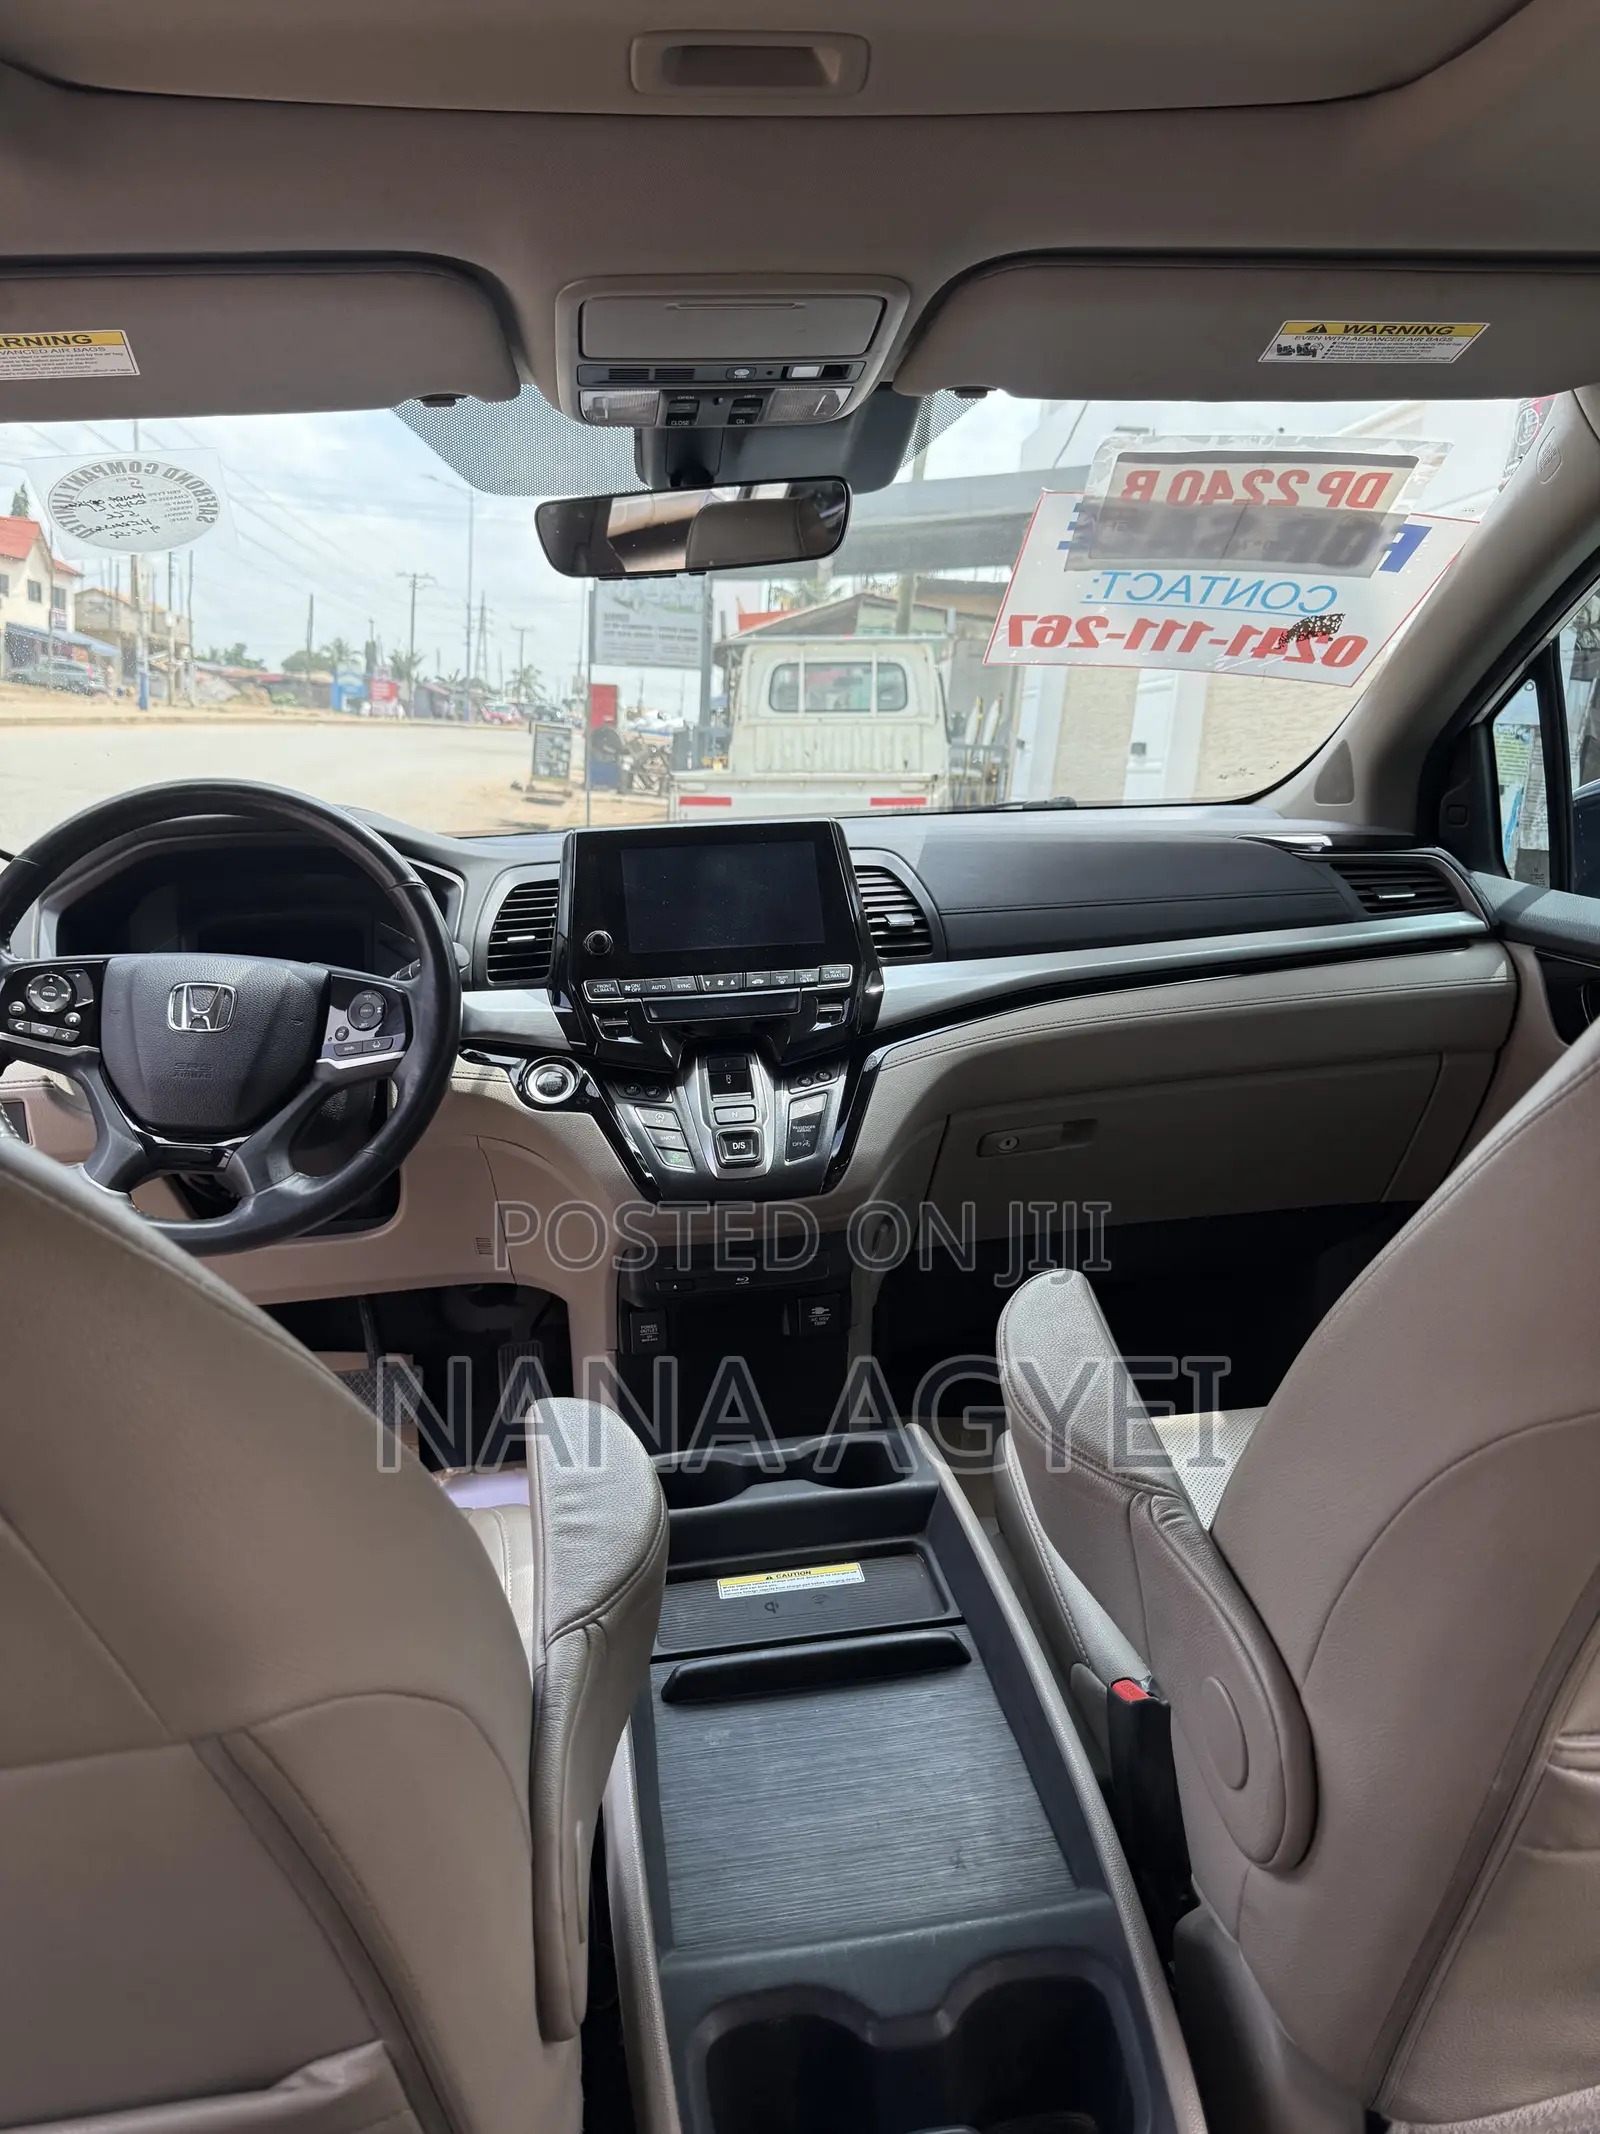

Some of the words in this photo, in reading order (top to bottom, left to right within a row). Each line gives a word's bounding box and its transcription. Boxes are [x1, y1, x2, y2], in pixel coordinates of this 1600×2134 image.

[1343, 324, 1455, 335] WARNING
[0, 334, 93, 348] RNING
[732, 1141, 746, 1150] D/S
[775, 1571, 812, 1579] CAUTION
